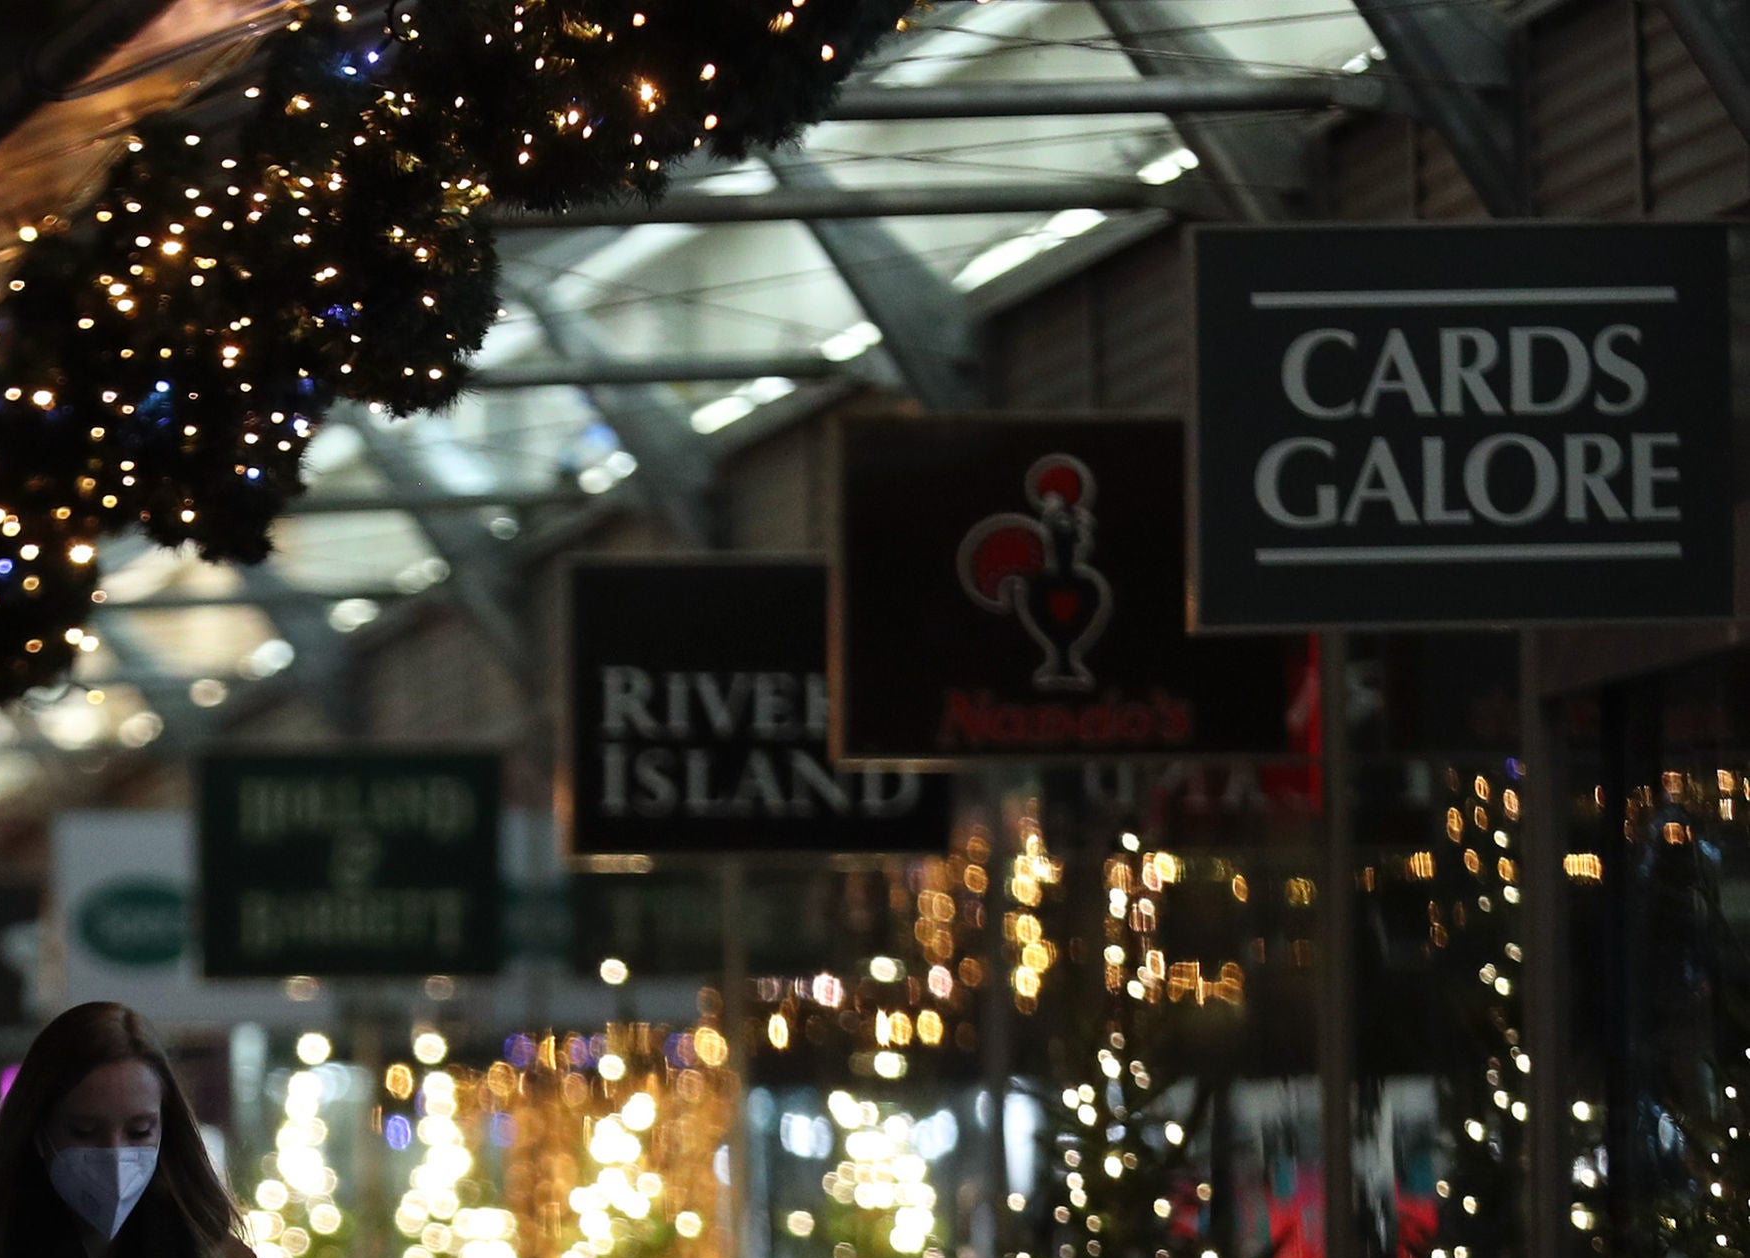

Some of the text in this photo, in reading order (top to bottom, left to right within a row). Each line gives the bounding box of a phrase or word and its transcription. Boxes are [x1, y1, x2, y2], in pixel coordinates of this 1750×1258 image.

[1280, 324, 1648, 420] CARDS
[1253, 433, 1682, 529] GALORE
[935, 688, 1194, 745] Nando's
[600, 741, 923, 818] ISLAND
